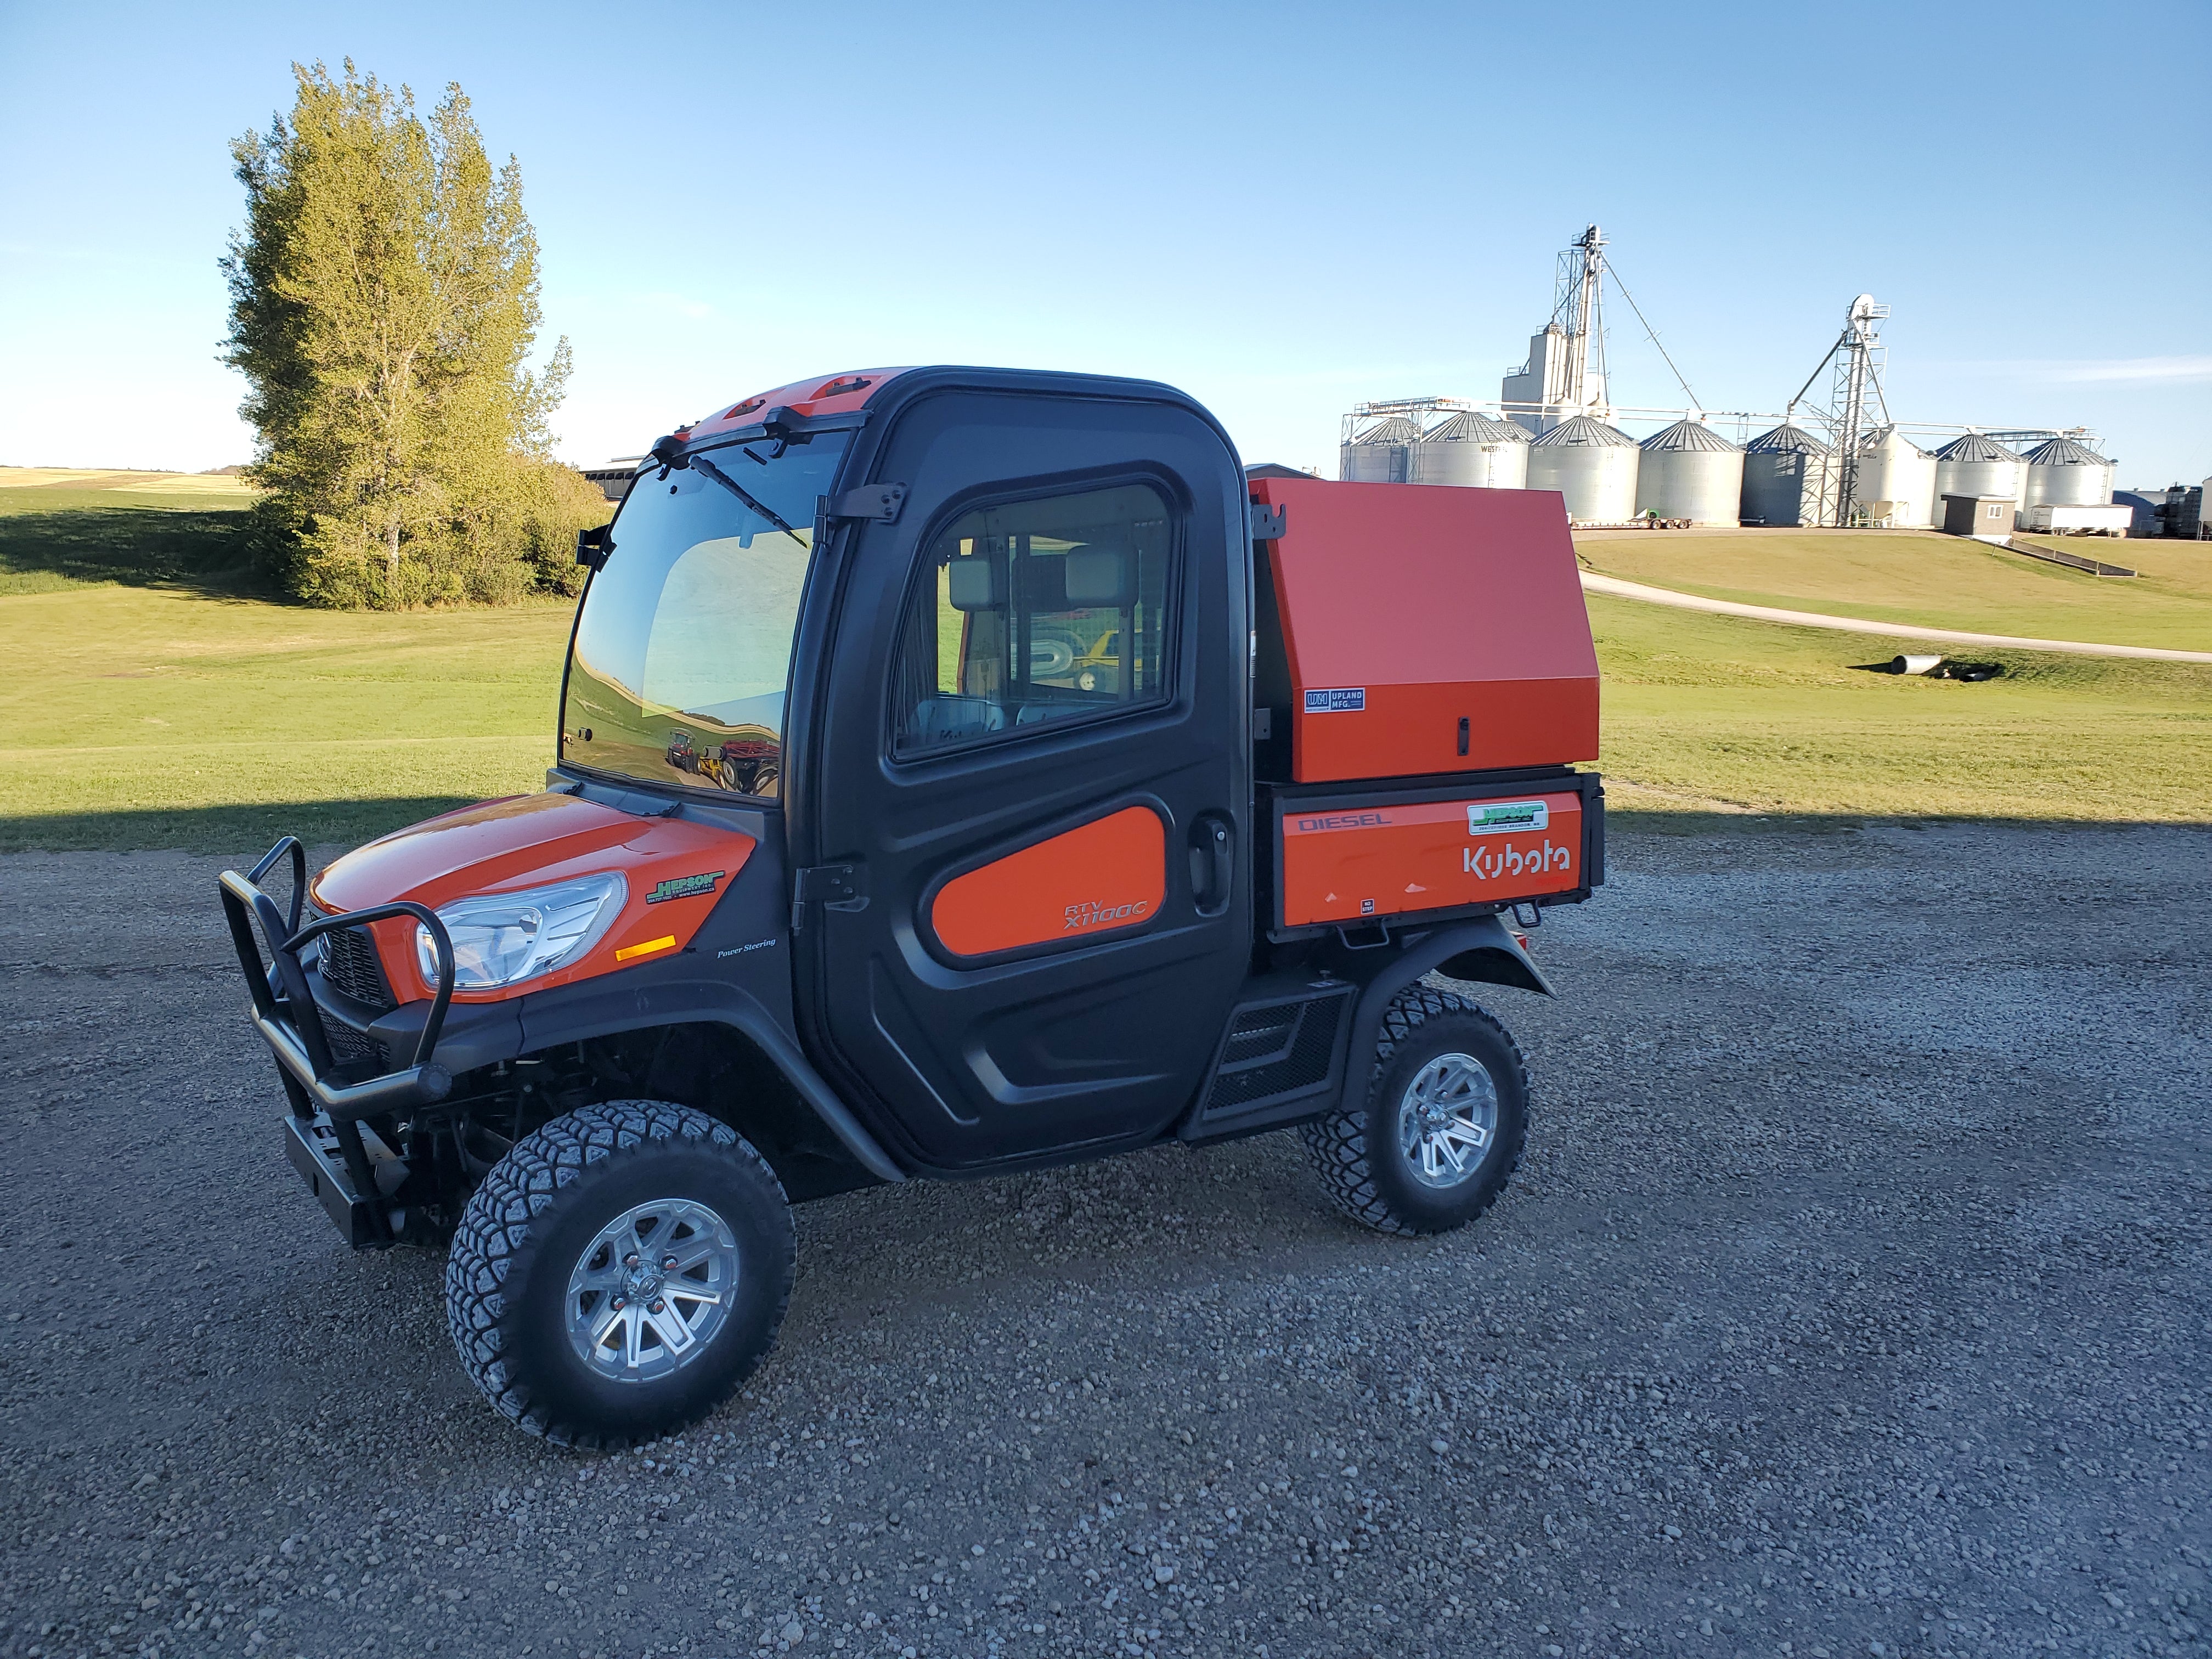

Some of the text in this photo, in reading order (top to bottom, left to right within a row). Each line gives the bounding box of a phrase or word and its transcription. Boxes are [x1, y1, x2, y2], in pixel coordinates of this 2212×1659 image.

[1331, 691, 1362, 700] UPLAND
[1331, 700, 1351, 708] MFG.
[1298, 814, 1392, 831] DIESEL
[1463, 839, 1570, 879] Kubota
[647, 871, 724, 899] HEPSON
[672, 885, 701, 894] EQUIPMENT
[679, 888, 714, 897] www.hepson.ca
[1064, 901, 1147, 929] X1100C
[1065, 900, 1103, 916] RTV
[717, 939, 776, 958] Power Steering
